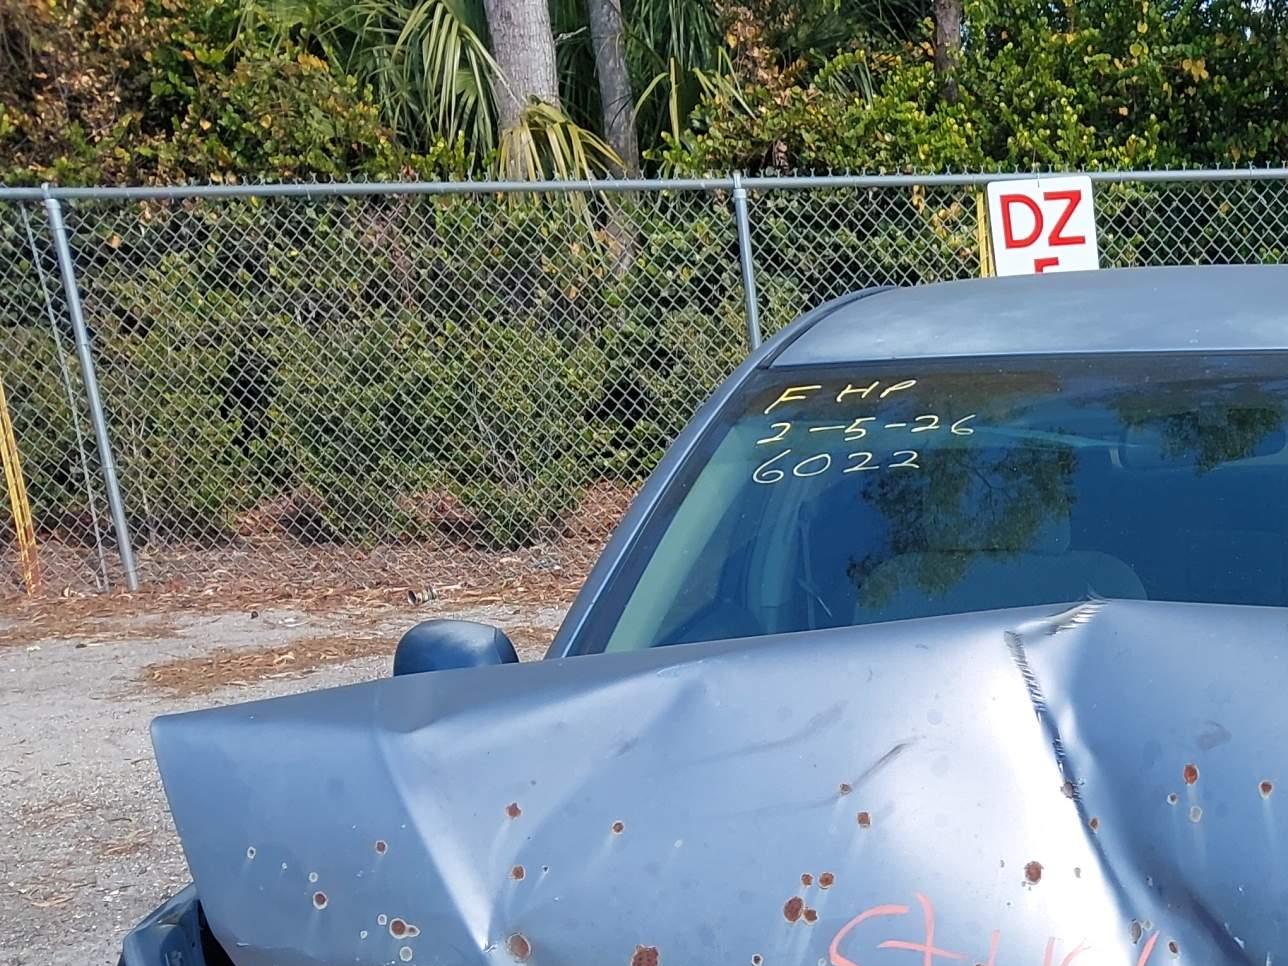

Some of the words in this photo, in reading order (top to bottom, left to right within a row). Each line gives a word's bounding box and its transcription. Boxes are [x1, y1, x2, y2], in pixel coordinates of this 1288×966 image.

[1000, 190, 1086, 249] DZ
[756, 415, 976, 445] 2-5-26
[752, 449, 920, 484] 6022
